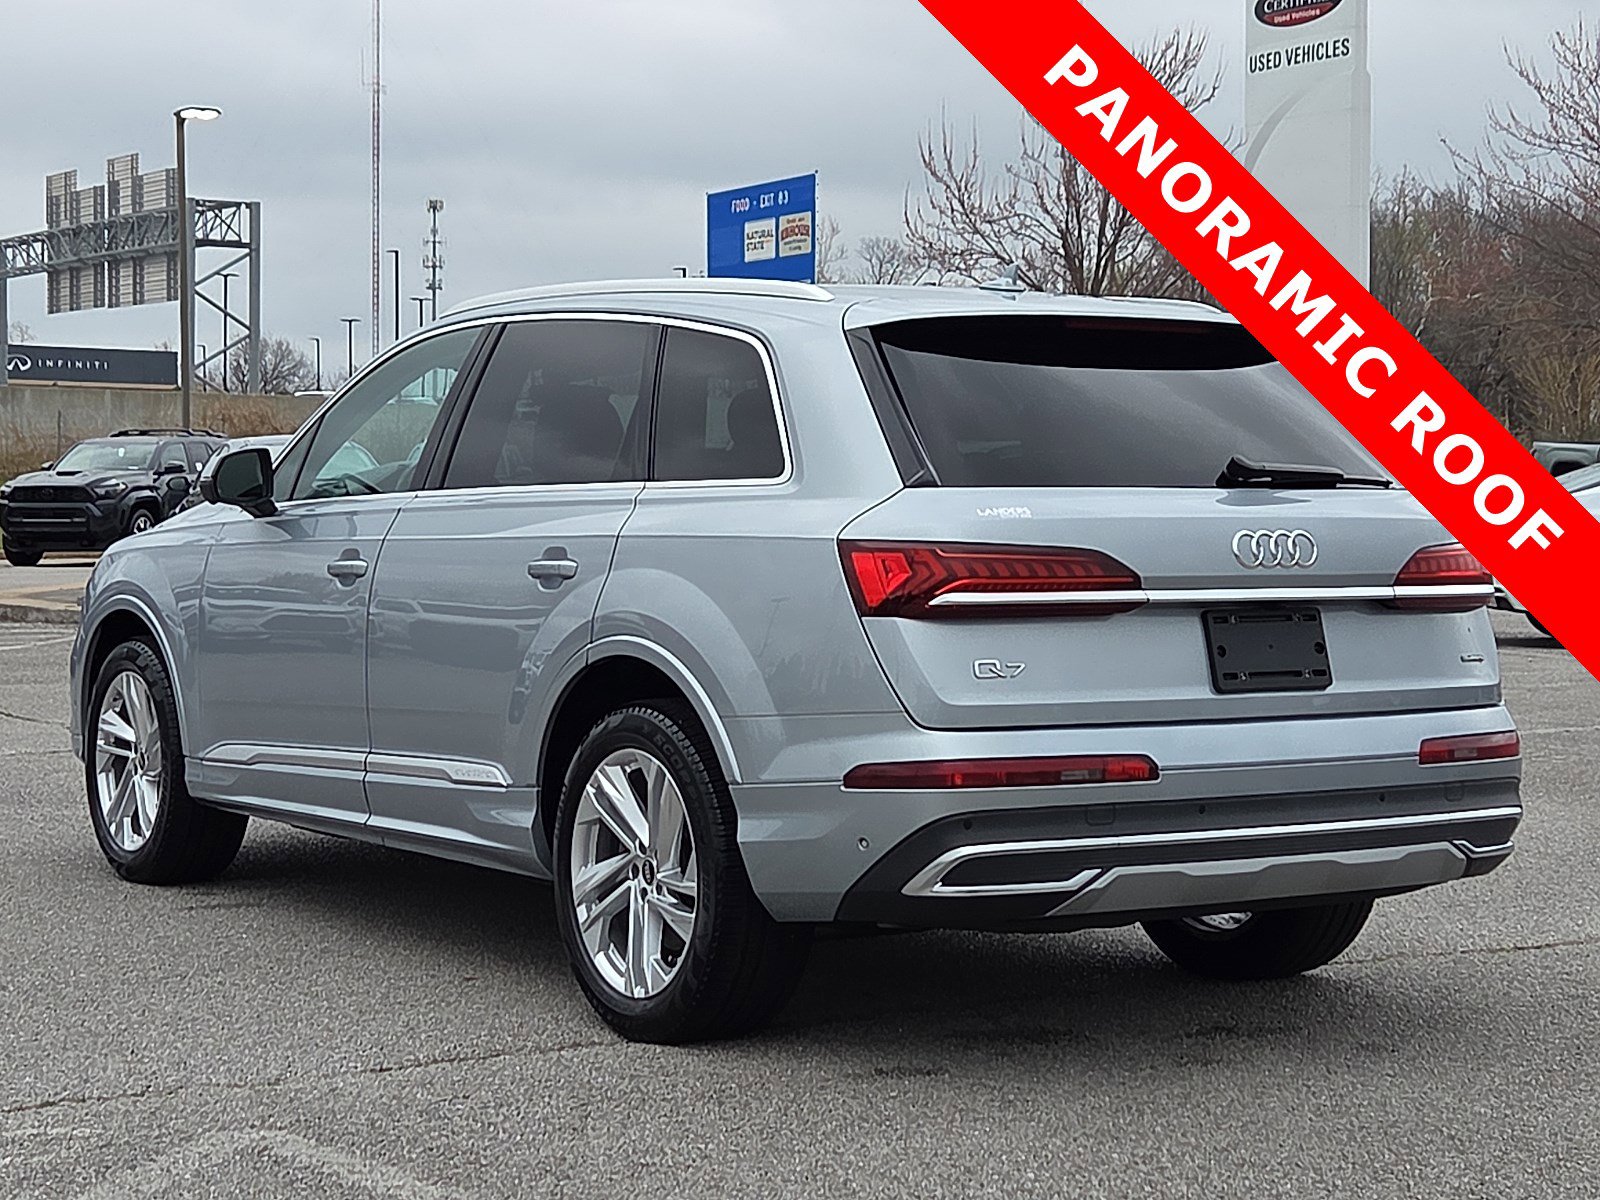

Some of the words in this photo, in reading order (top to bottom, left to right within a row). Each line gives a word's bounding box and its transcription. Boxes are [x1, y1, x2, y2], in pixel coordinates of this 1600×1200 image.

[1263, 0, 1328, 13] CERTI
[1291, 8, 1320, 20] Vehicles
[1249, 50, 1281, 74] USED
[1285, 38, 1350, 67] VEHICLES
[731, 197, 750, 213] FOOD
[37, 358, 109, 370] INFINITI
[972, 658, 1026, 680] Q7
